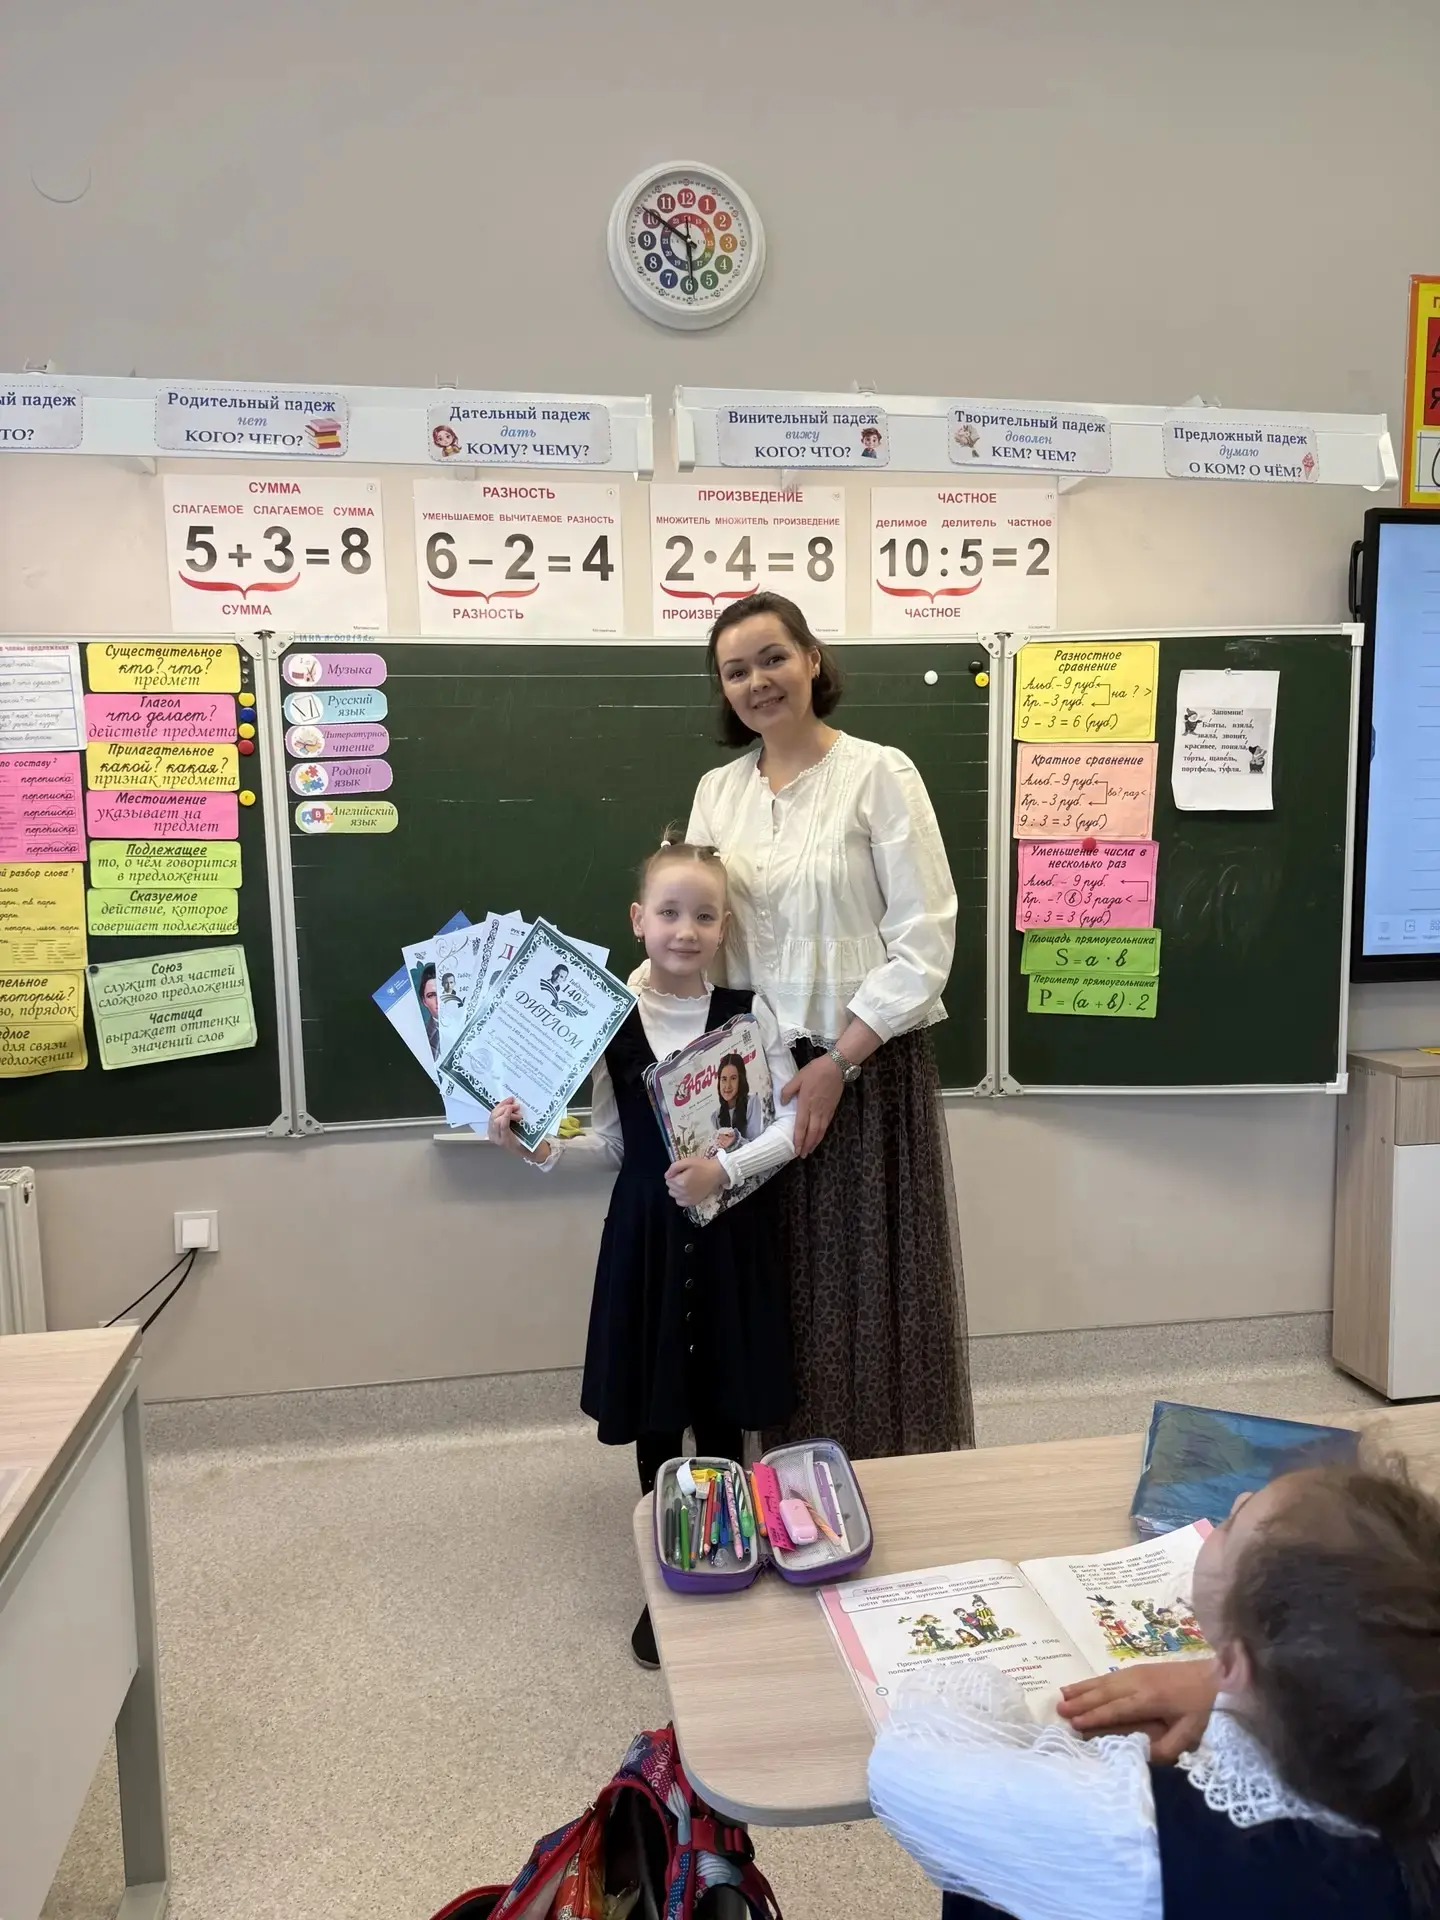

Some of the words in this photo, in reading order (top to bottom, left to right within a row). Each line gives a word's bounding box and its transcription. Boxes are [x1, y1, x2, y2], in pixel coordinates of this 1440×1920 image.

[661, 197, 672, 210] 11
[680, 193, 694, 205] 12
[22, 393, 76, 408] падеж
[167, 392, 279, 411] Родительный
[284, 398, 336, 413] падеж
[449, 406, 536, 422] Дательный
[541, 409, 591, 423] падеж
[728, 411, 828, 425] Винительный
[833, 412, 879, 426] падеж
[237, 416, 268, 427] нет
[955, 411, 1058, 430] Творительный
[1062, 420, 1106, 433] падеж
[184, 431, 244, 444] КОГО?
[249, 433, 303, 447] ЧЕГО?
[500, 426, 536, 439] дать
[785, 430, 820, 442] вижу
[1006, 431, 1053, 444] доволен
[1174, 427, 1263, 443] Предложный
[1267, 432, 1308, 445] падеж
[467, 443, 528, 457] КОМУ?
[533, 444, 590, 459] ЧЕМУ?
[754, 446, 806, 458] КОГО?
[811, 446, 851, 459] ЧТО?
[991, 446, 1032, 460] КЕМ?
[1036, 449, 1077, 462] ЧЕМ?
[1219, 446, 1259, 459] думаю
[1189, 462, 1200, 474] О
[1204, 463, 1246, 476] КОМ?
[1249, 465, 1261, 477] О
[1265, 462, 1303, 478] ЧЁМ?
[249, 482, 301, 495] СУММА
[482, 487, 556, 500] РАЗНОСТЬ
[698, 490, 803, 503] ПРОИЗВЕДЕНИЕ
[937, 492, 997, 504] ЧАСТНОЕ
[172, 504, 244, 515] СЛАГАЕМОЕ
[253, 505, 324, 516] СЛАГАЕМОЕ
[333, 506, 375, 517] СУММА
[422, 512, 495, 523] УМЕНЬШАЕМОЕ
[499, 513, 562, 524] ВЫЧИТАЕМОЕ
[567, 514, 615, 525] РАЗНОСТЬ
[656, 516, 711, 525] МНОЖИТЕЛЬ
[715, 516, 769, 526] МНОЖИТЕЛЬ
[773, 516, 840, 526] ПРОИЗВЕДЕНИЕ
[876, 518, 928, 529] делимое
[941, 517, 997, 529] делитель
[1007, 518, 1052, 528] частное
[222, 604, 272, 616] СУММА
[452, 608, 524, 620] РАЗНОСТЬ
[662, 609, 721, 620] ПРОИЗВЕ
[904, 607, 961, 618] ЧАСТНОЕ
[105, 645, 223, 658] Существительное
[1054, 650, 1122, 661] Разностное
[118, 657, 164, 675] кто?
[168, 657, 213, 675] что?
[327, 664, 372, 676] Музыка
[1058, 662, 1117, 673] сравнение
[134, 671, 200, 689] предмет
[140, 696, 181, 708] Глагол
[327, 694, 373, 706] Русский
[106, 712, 141, 722] что
[146, 705, 218, 729] делает?
[338, 708, 366, 717] язык
[1212, 708, 1244, 716] Запомни!
[89, 723, 160, 739] действие
[163, 724, 237, 741] предмета
[323, 728, 387, 739] Литературное
[108, 744, 214, 757] Прилагательное
[332, 743, 375, 752] чтение
[100, 757, 163, 773] какой?
[166, 757, 229, 774] какая?
[1031, 755, 1081, 766] Кратное
[1085, 756, 1144, 766] сравнение
[331, 765, 371, 776] Родной
[21, 775, 72, 786] переписка
[94, 774, 162, 788] признак
[162, 772, 237, 788] предмета
[334, 778, 361, 788] язык
[22, 792, 73, 803] переписка
[115, 792, 207, 805] Местоимение
[94, 807, 180, 822] указывает
[185, 809, 201, 820] на
[331, 806, 394, 817] Английский
[154, 817, 219, 835] предмет
[350, 818, 378, 827] язык
[126, 843, 207, 857] Подлежащее
[1031, 845, 1099, 857] Уменьшение
[1104, 848, 1134, 857] числа
[1140, 848, 1146, 857] в
[98, 858, 120, 869] то,
[124, 860, 133, 868] о
[137, 855, 163, 868] чём
[166, 858, 238, 872] говорится
[1048, 859, 1103, 869] несколько
[1107, 861, 1127, 870] раз
[10, 868, 40, 878] разбор
[117, 873, 125, 882] в
[129, 868, 219, 885] предложении
[130, 891, 198, 904] Сказуемое
[101, 901, 167, 916] действие,
[171, 904, 228, 919] которое
[91, 920, 158, 935] совершает
[162, 918, 238, 935] подлежащее
[1029, 934, 1071, 945] Площадь
[1075, 936, 1155, 946] прямоугольника
[1056, 949, 1068, 966] S
[151, 962, 183, 975] Союз
[103, 978, 156, 996] служит
[161, 973, 184, 986] для
[188, 965, 235, 981] частей
[1033, 975, 1079, 985] Периметр
[1082, 977, 1155, 988] прямоугольника
[98, 990, 159, 1008] сложного
[162, 978, 245, 1003] предложения
[562, 984, 582, 1002] 140
[20, 1002, 78, 1020] порядок
[149, 1007, 203, 1025] Частица
[515, 990, 584, 1049] ДИПЛОМ
[105, 1024, 176, 1045] выражает
[180, 1015, 240, 1034] оттенки
[2, 1040, 25, 1052] для
[30, 1041, 67, 1052] связи
[131, 1037, 193, 1054] значений
[197, 1031, 225, 1044] слов
